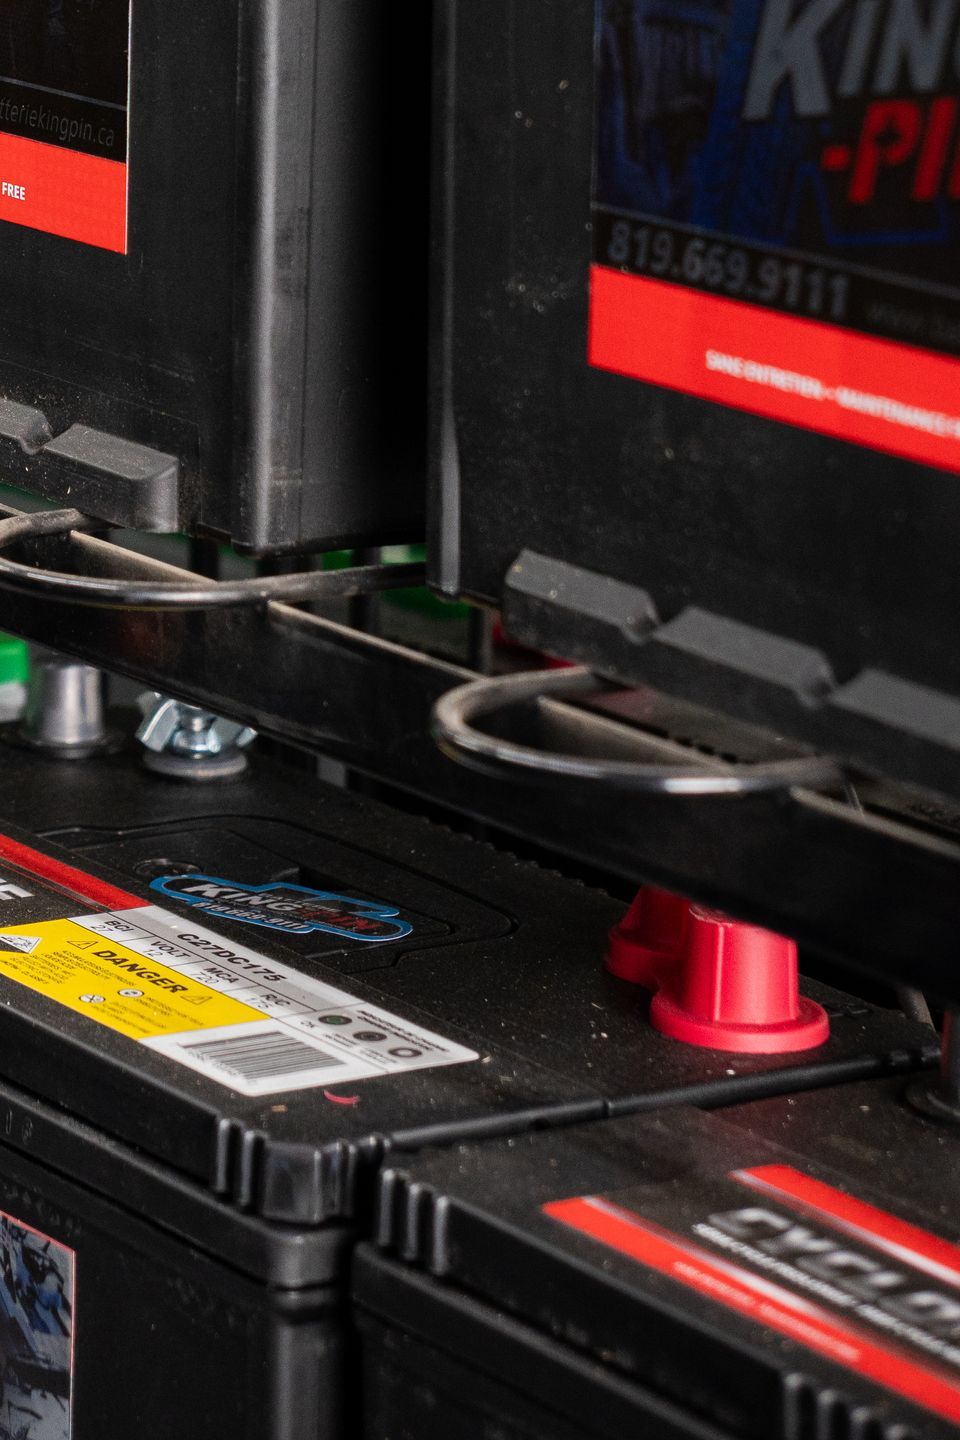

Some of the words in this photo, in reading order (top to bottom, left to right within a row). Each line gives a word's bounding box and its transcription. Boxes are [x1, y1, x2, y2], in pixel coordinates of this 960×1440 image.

[819, 96, 960, 206] -PI
[1, 182, 26, 201] FREE
[607, 218, 850, 318] 819.669.9111
[181, 883, 304, 912] KING
[87, 923, 115, 933] 27
[101, 920, 135, 932] BCI
[145, 940, 193, 959] VOLT
[172, 932, 290, 982] C27DC175
[87, 949, 194, 993] DANGER
[199, 966, 244, 983] MCA
[256, 993, 294, 1007] R/C
